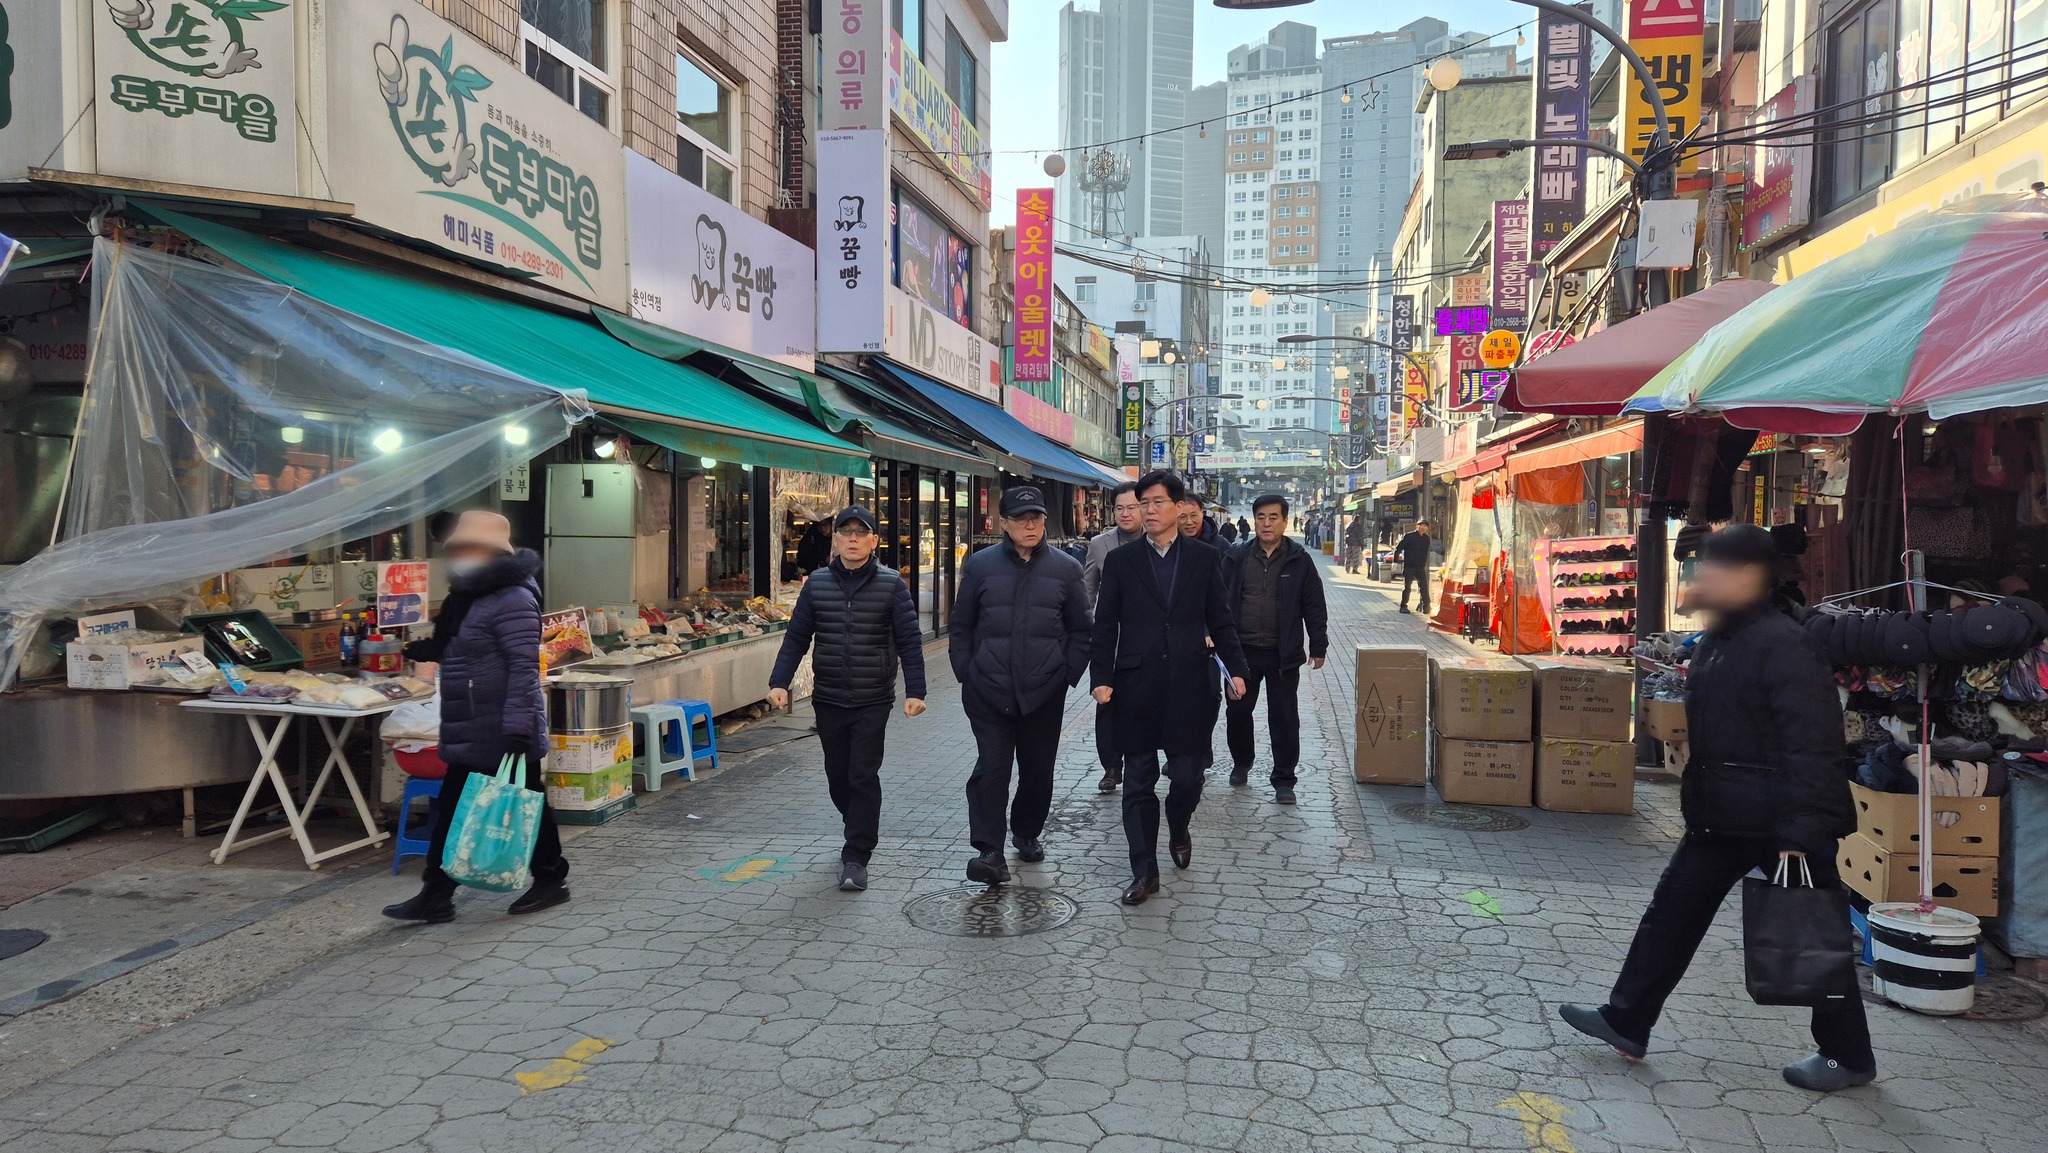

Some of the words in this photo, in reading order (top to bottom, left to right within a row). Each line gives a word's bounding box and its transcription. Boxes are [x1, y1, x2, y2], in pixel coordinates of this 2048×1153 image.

[835, 50, 866, 110] 의류
[903, 50, 951, 137] BILLIARDS
[116, 79, 273, 139] 두부마을
[487, 103, 502, 124] 몸과
[506, 114, 527, 139] 마음을
[1541, 103, 1579, 203] 노래빠
[485, 134, 599, 262] 두부마을
[1543, 222, 1574, 234] 지하
[500, 241, 564, 280] 010-4289-2301
[731, 252, 777, 321] 꿈빵
[839, 237, 862, 289] 꿈빵
[1018, 193, 1048, 357] 속옷아울렛
[632, 288, 662, 313] 용인역점
[909, 299, 937, 371] MD
[938, 346, 967, 382] STORY
[1484, 349, 1517, 360] 파출부
[1015, 363, 1050, 378] 란제리일체
[1125, 402, 1140, 459] 산타마트
[1341, 388, 1350, 418] BYC
